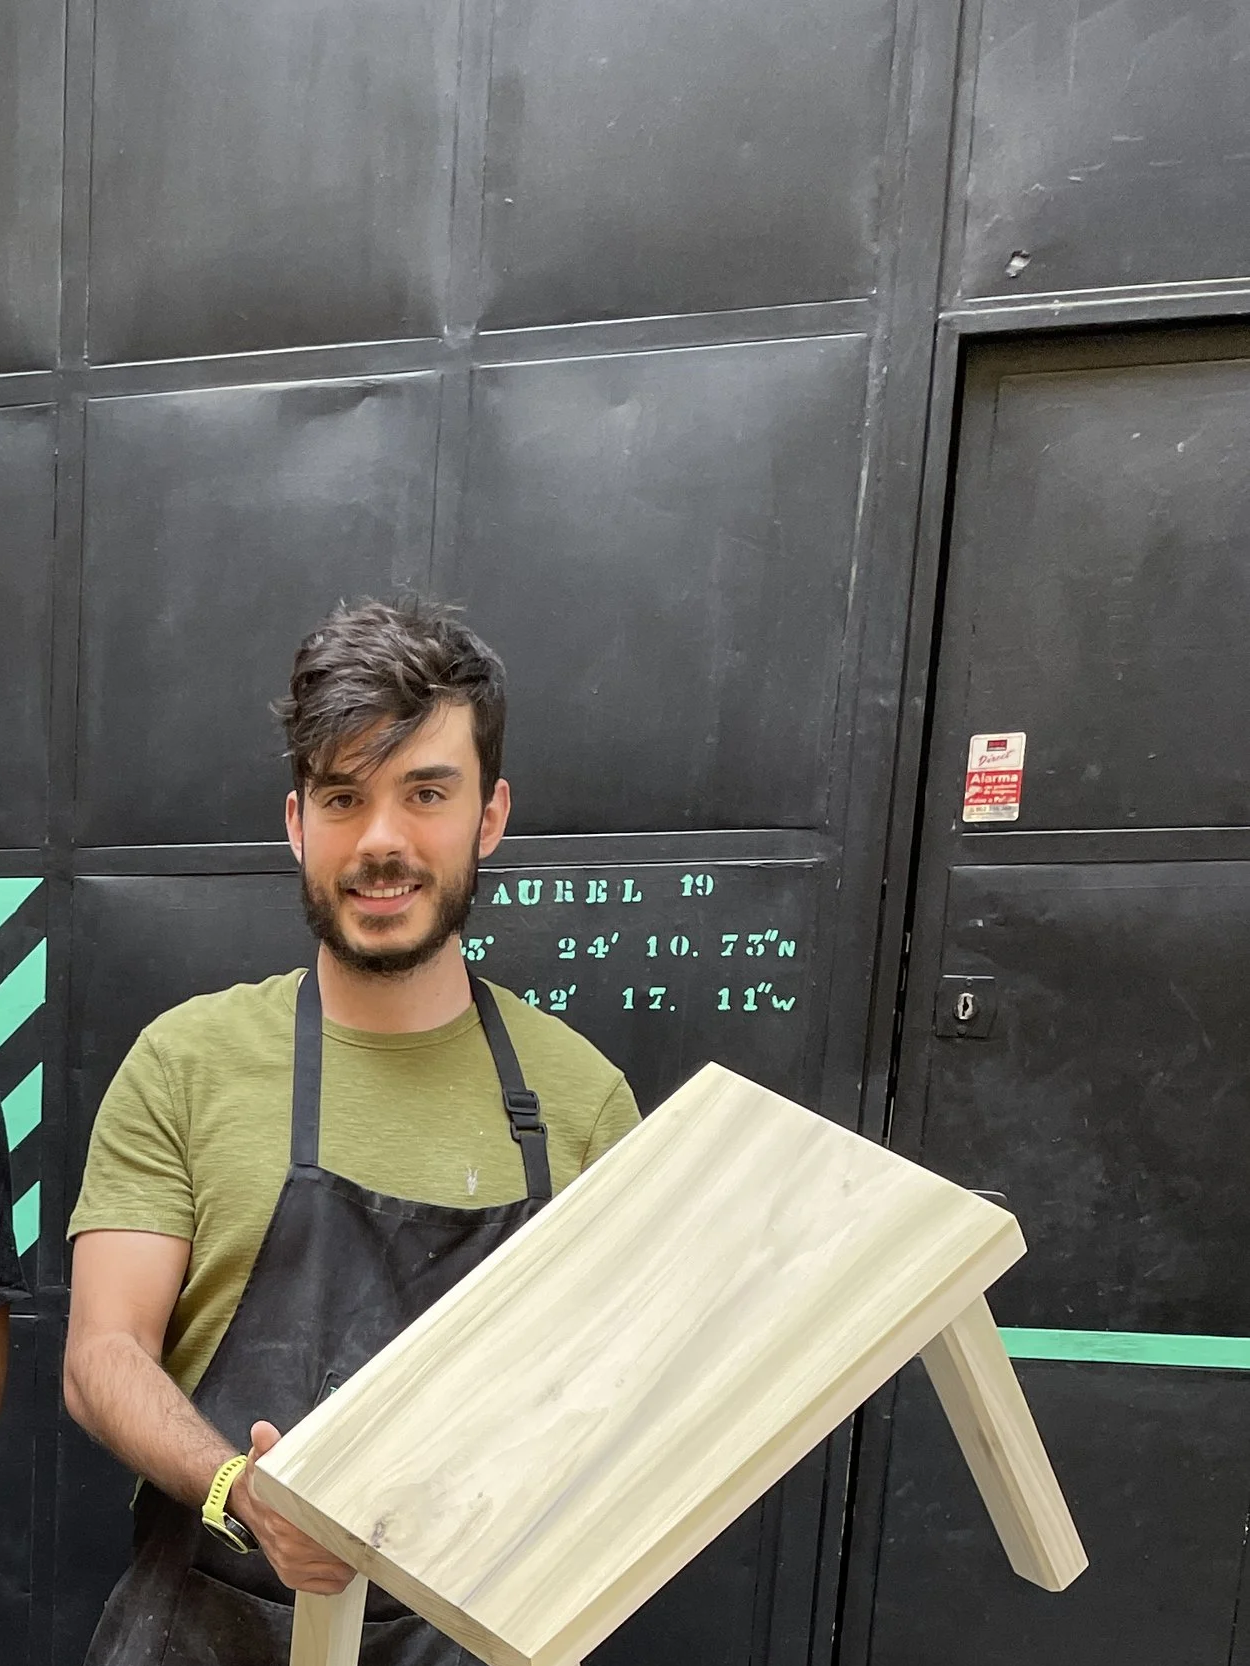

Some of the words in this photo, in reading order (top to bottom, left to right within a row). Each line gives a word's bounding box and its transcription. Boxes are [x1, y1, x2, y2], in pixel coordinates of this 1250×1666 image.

[970, 773, 1018, 784] Alarma
[471, 879, 642, 905] AUREL
[680, 874, 714, 897] 19
